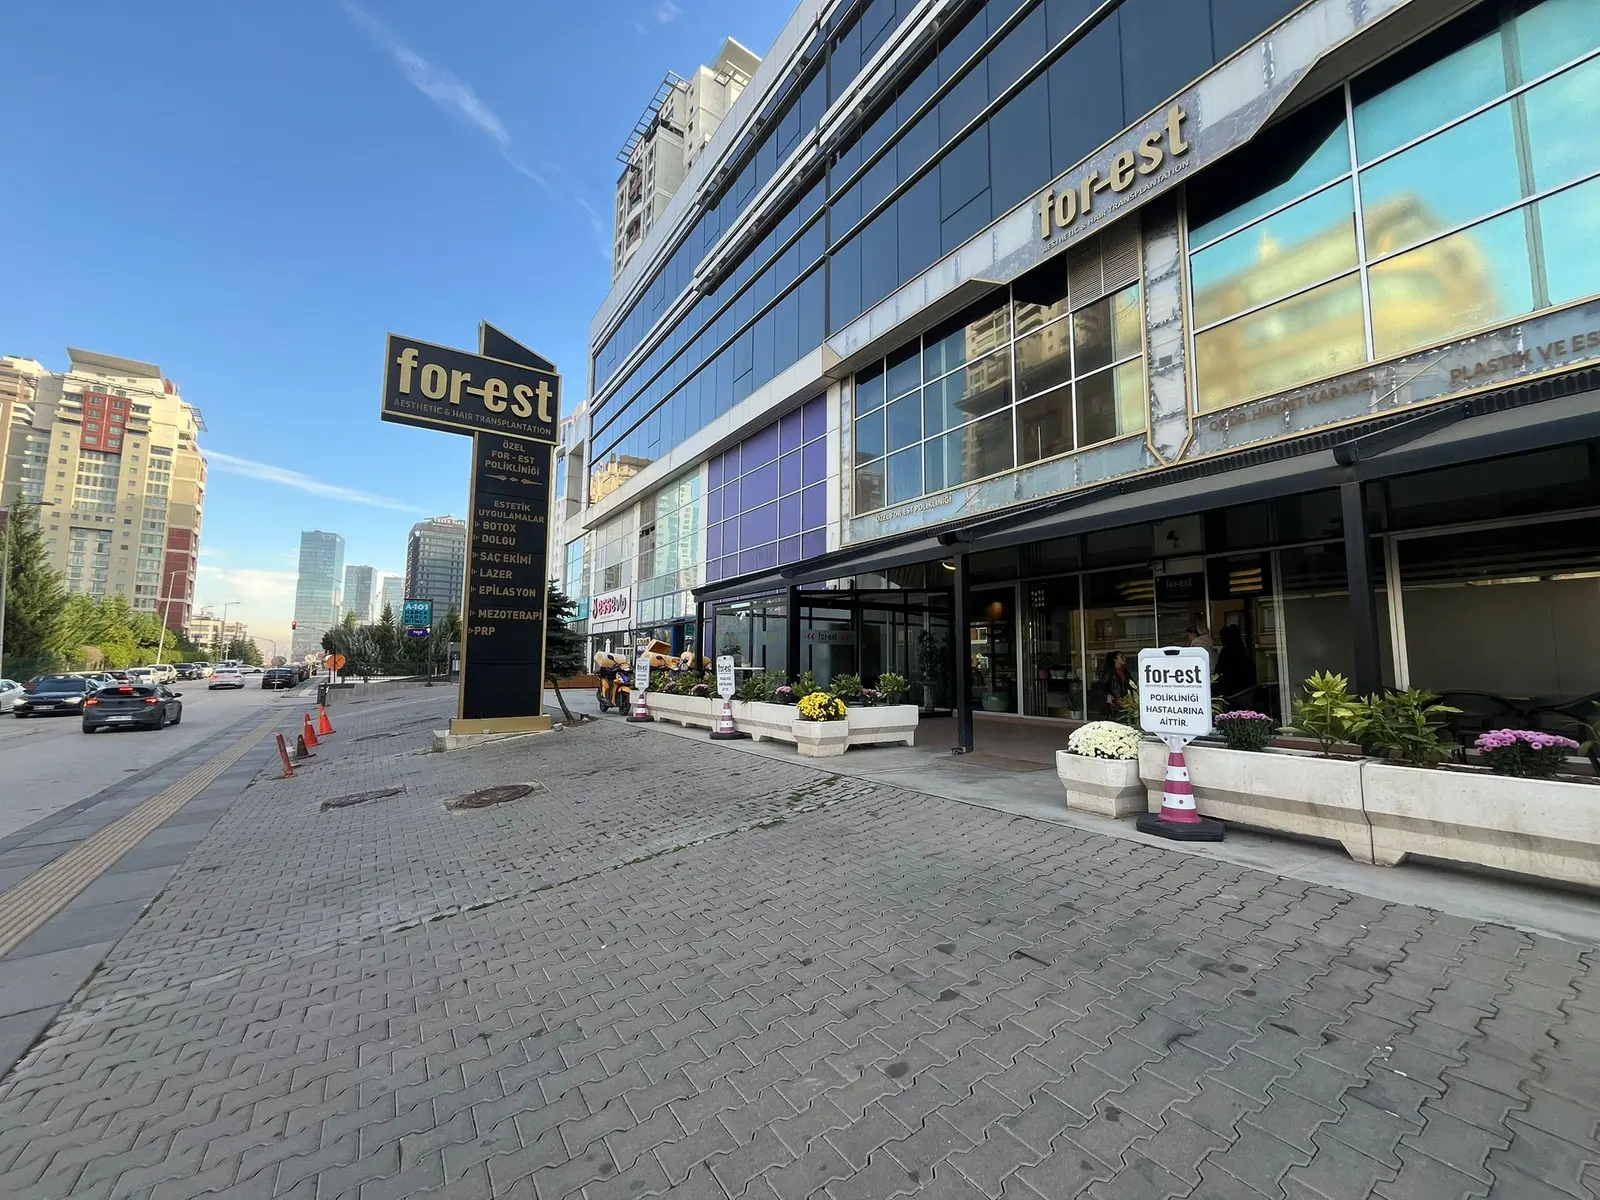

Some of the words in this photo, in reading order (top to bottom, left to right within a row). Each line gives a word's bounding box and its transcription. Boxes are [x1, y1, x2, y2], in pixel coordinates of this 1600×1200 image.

[1038, 104, 1189, 240] for-est
[1043, 227, 1080, 253] AESTHETIC
[1109, 158, 1190, 213] TRANSPLANTATION
[1536, 340, 1567, 361] VE
[1572, 330, 1600, 352] ES
[396, 347, 553, 423] for-est
[393, 398, 443, 414] AESTHETIC
[444, 408, 450, 416] &
[452, 410, 473, 421] HAIR
[475, 414, 551, 435] TRANSPLANTATION
[502, 440, 525, 452] ÖZEL
[485, 459, 540, 475] POLİKLİNİĞİ
[494, 500, 531, 511] ESTETİK
[478, 509, 545, 523] UYGULAMALAR
[483, 521, 517, 533] BOTOX
[481, 534, 516, 546] DOLGU
[480, 552, 500, 563] SAÇ
[503, 553, 532, 565] EKİMİ
[480, 568, 513, 579] LAZER
[479, 584, 536, 597] EPİLASYON
[478, 609, 543, 621] MEZOTERAPİ
[474, 626, 496, 635] PRP
[1144, 664, 1202, 684] for-est
[1150, 693, 1199, 702] POLİKLİNİĞİ
[1146, 705, 1204, 715] HASTALARINA
[1160, 718, 1188, 727] AİTTİR.
